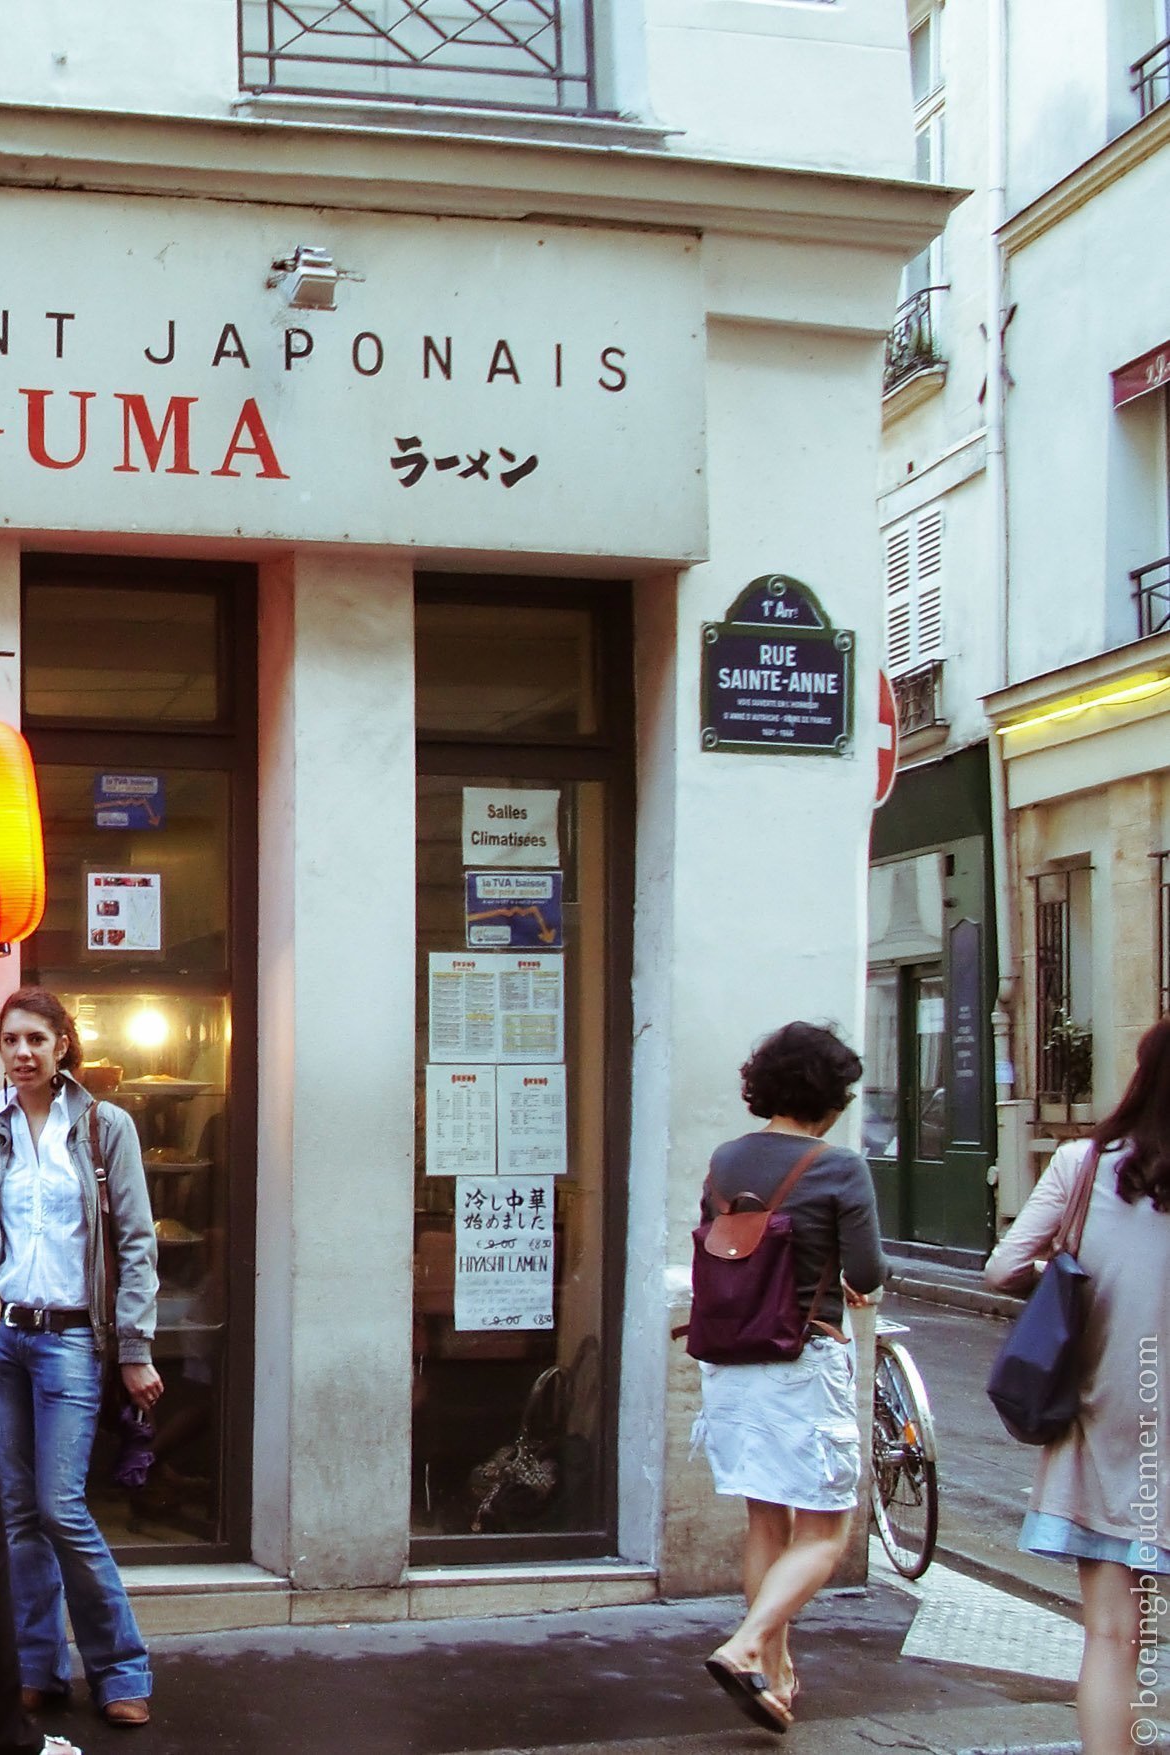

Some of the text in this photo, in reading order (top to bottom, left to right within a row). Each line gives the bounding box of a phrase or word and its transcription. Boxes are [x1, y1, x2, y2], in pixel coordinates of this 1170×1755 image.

[144, 318, 630, 393] JAPONAIS
[390, 435, 539, 489] ラーメン
[759, 644, 798, 667] RUE
[718, 667, 839, 695] SAINTE-ANNE
[487, 804, 528, 820] Salles
[471, 830, 547, 848] Climatisées
[492, 878, 512, 887] TVA
[465, 1187, 547, 1214] 冷し中華
[463, 1213, 546, 1230] 始めました
[459, 1256, 548, 1273] HIYASHI LAMEN
